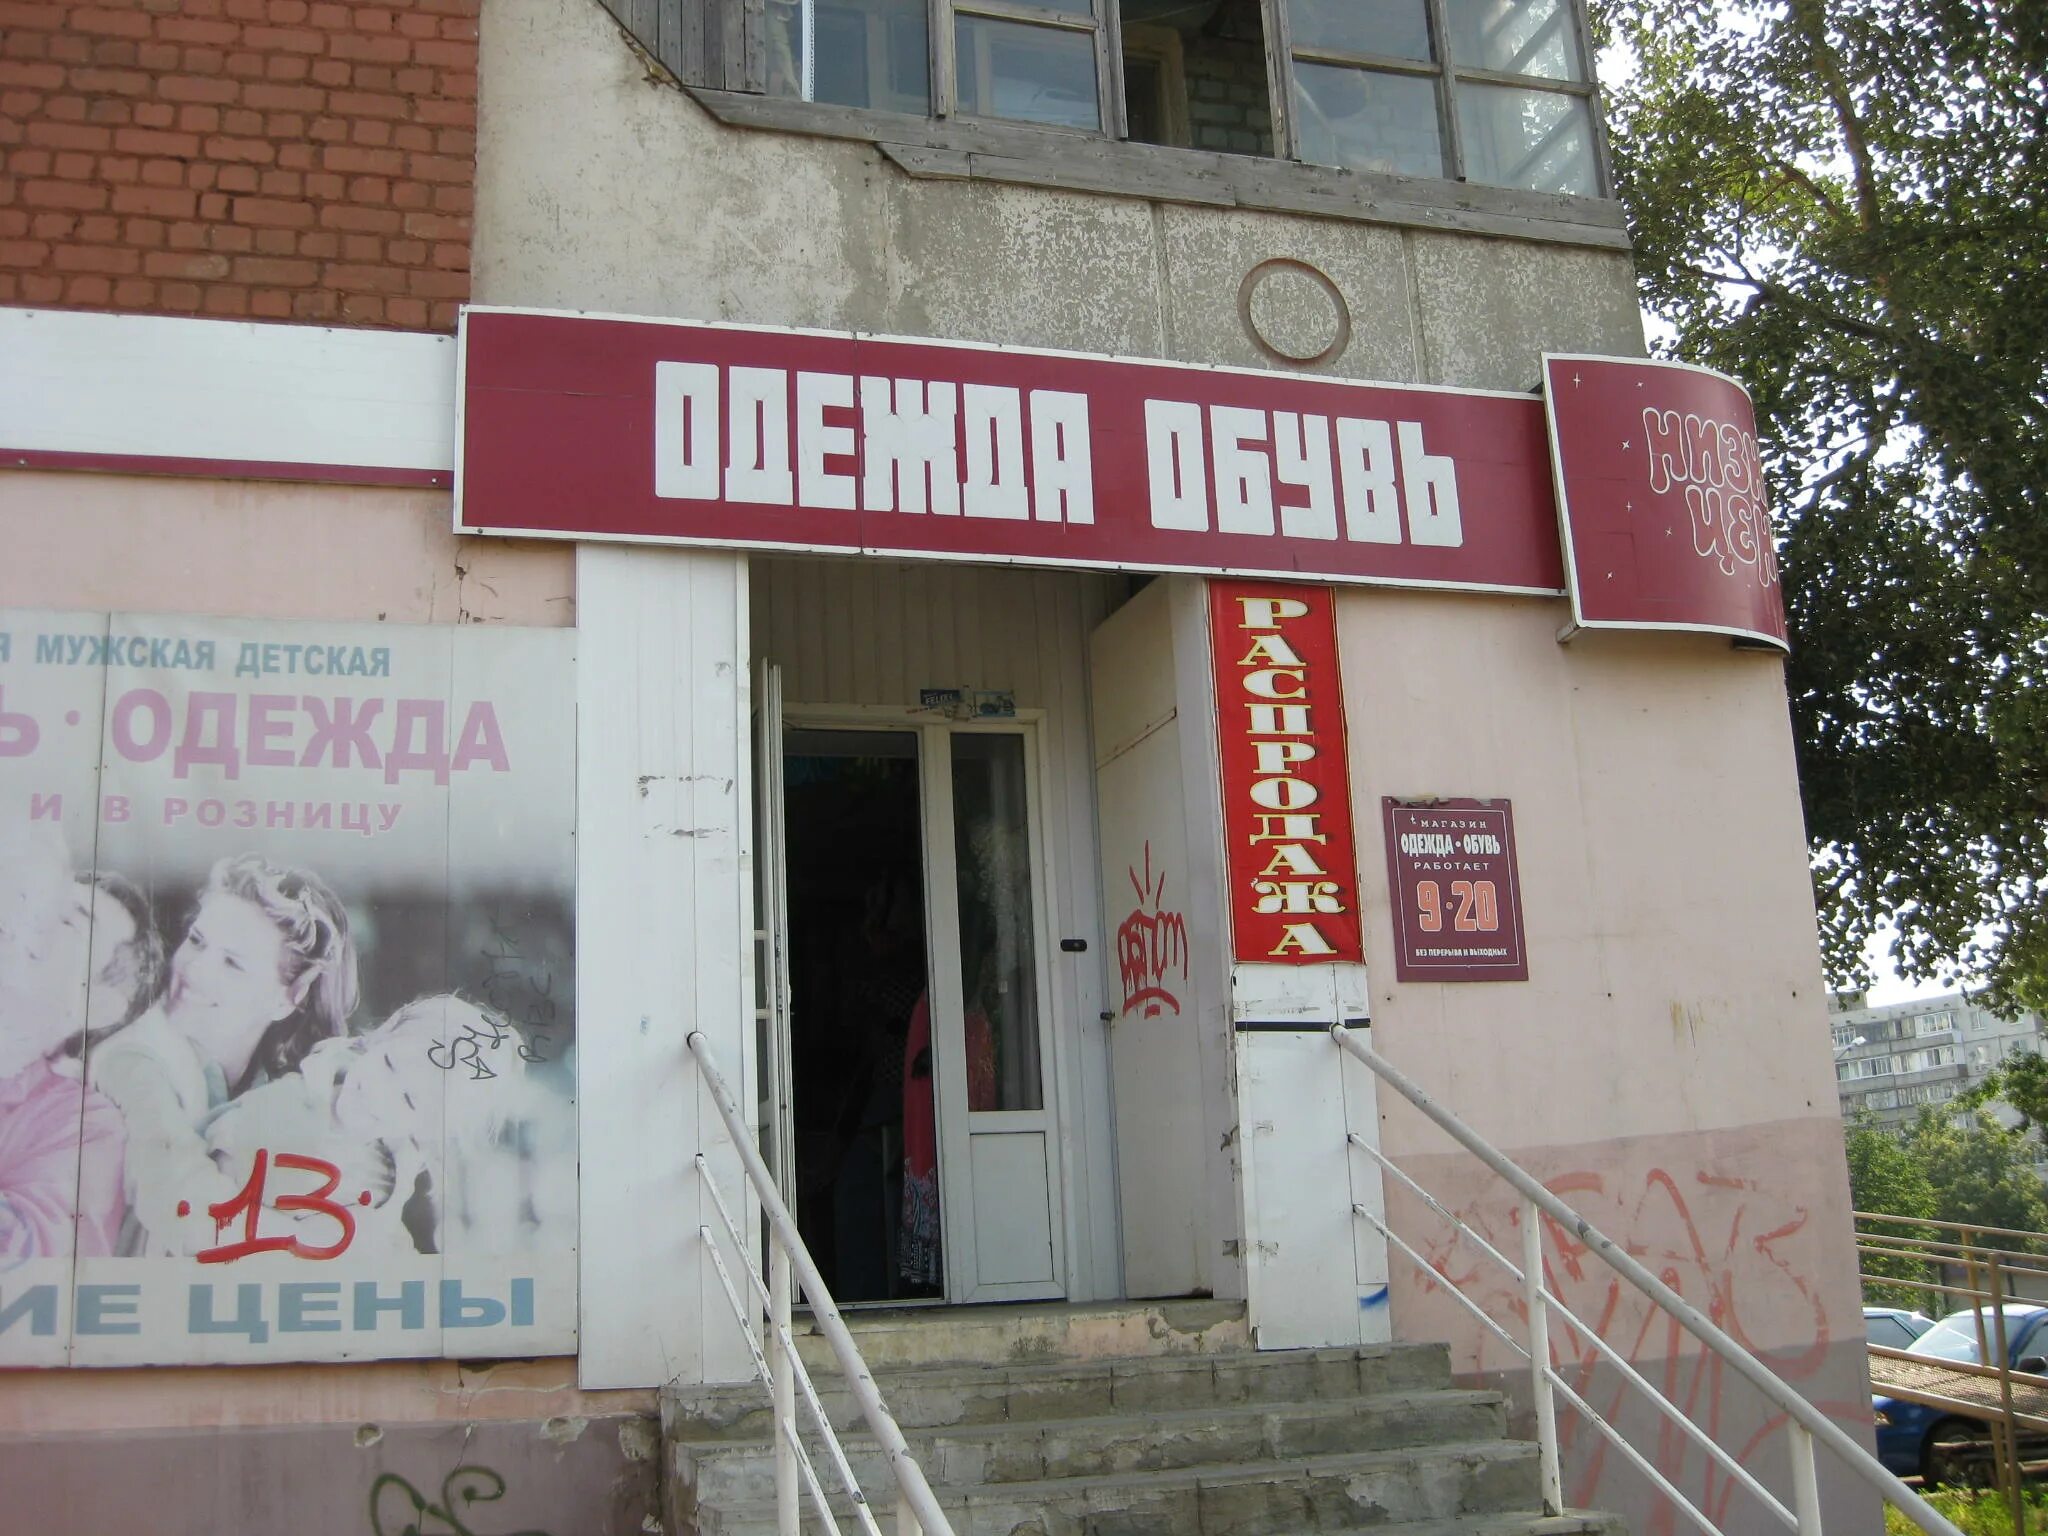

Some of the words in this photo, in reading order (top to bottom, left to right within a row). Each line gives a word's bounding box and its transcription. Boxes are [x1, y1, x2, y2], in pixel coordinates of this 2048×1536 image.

[655, 360, 1094, 525] ОДЕЖДА
[1144, 398, 1463, 548] ОБУВЬ
[36, 633, 216, 672] МУЖСКАЯ
[235, 642, 391, 678] ДЕТСКАЯ
[111, 688, 511, 786] ОДЕЖДА
[1236, 597, 1346, 956] РАСПРОДАЖА
[30, 793, 62, 822] И
[103, 795, 131, 823] В
[164, 797, 402, 836] РОЗНИЦУ
[1421, 819, 1487, 829] МАГАЗИН
[1400, 833, 1454, 857] ОДЕЖДА
[1463, 834, 1500, 855] ОБУВЬ
[1414, 861, 1489, 871] РАБОТАЕТ
[188, 1277, 535, 1344] ЦЕНЫ
